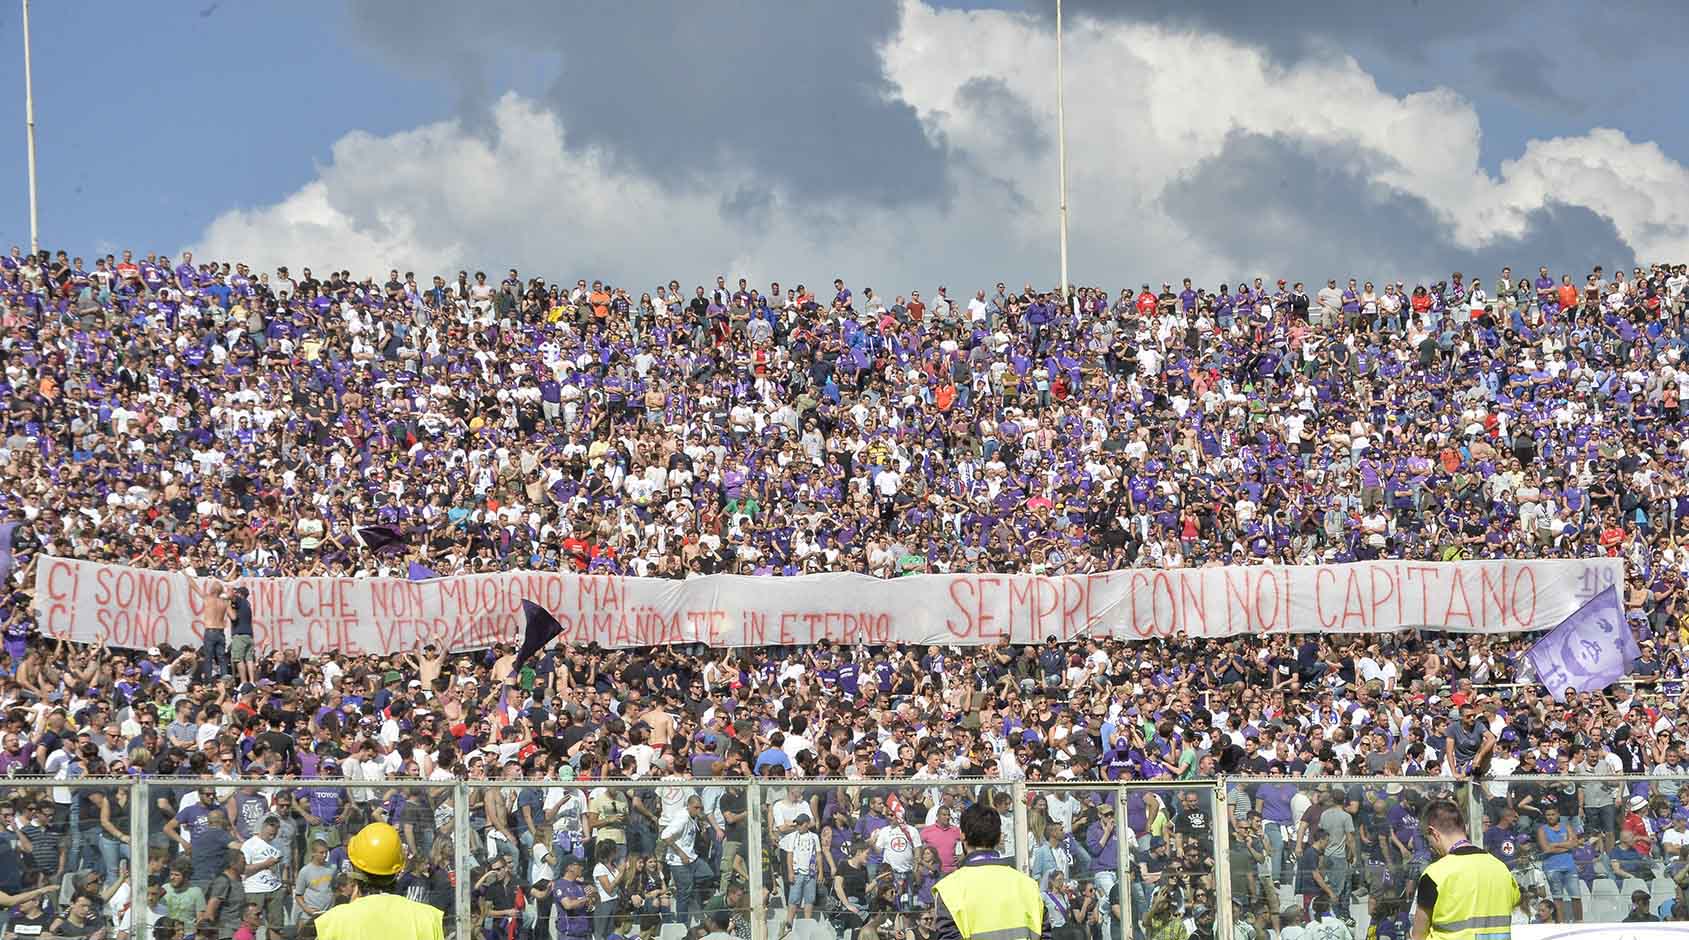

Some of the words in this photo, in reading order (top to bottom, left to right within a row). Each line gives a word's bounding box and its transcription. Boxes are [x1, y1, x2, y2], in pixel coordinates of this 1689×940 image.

[95, 567, 171, 613] SONO
[297, 579, 357, 617] CHE
[371, 579, 424, 618] NON
[946, 574, 1112, 640] SEMPRE
[1131, 569, 1208, 638] CON
[96, 608, 169, 648] SONO
[307, 619, 364, 655] CHE
[375, 614, 518, 654] VERRANNO
[561, 609, 726, 645] RAMANDATE
